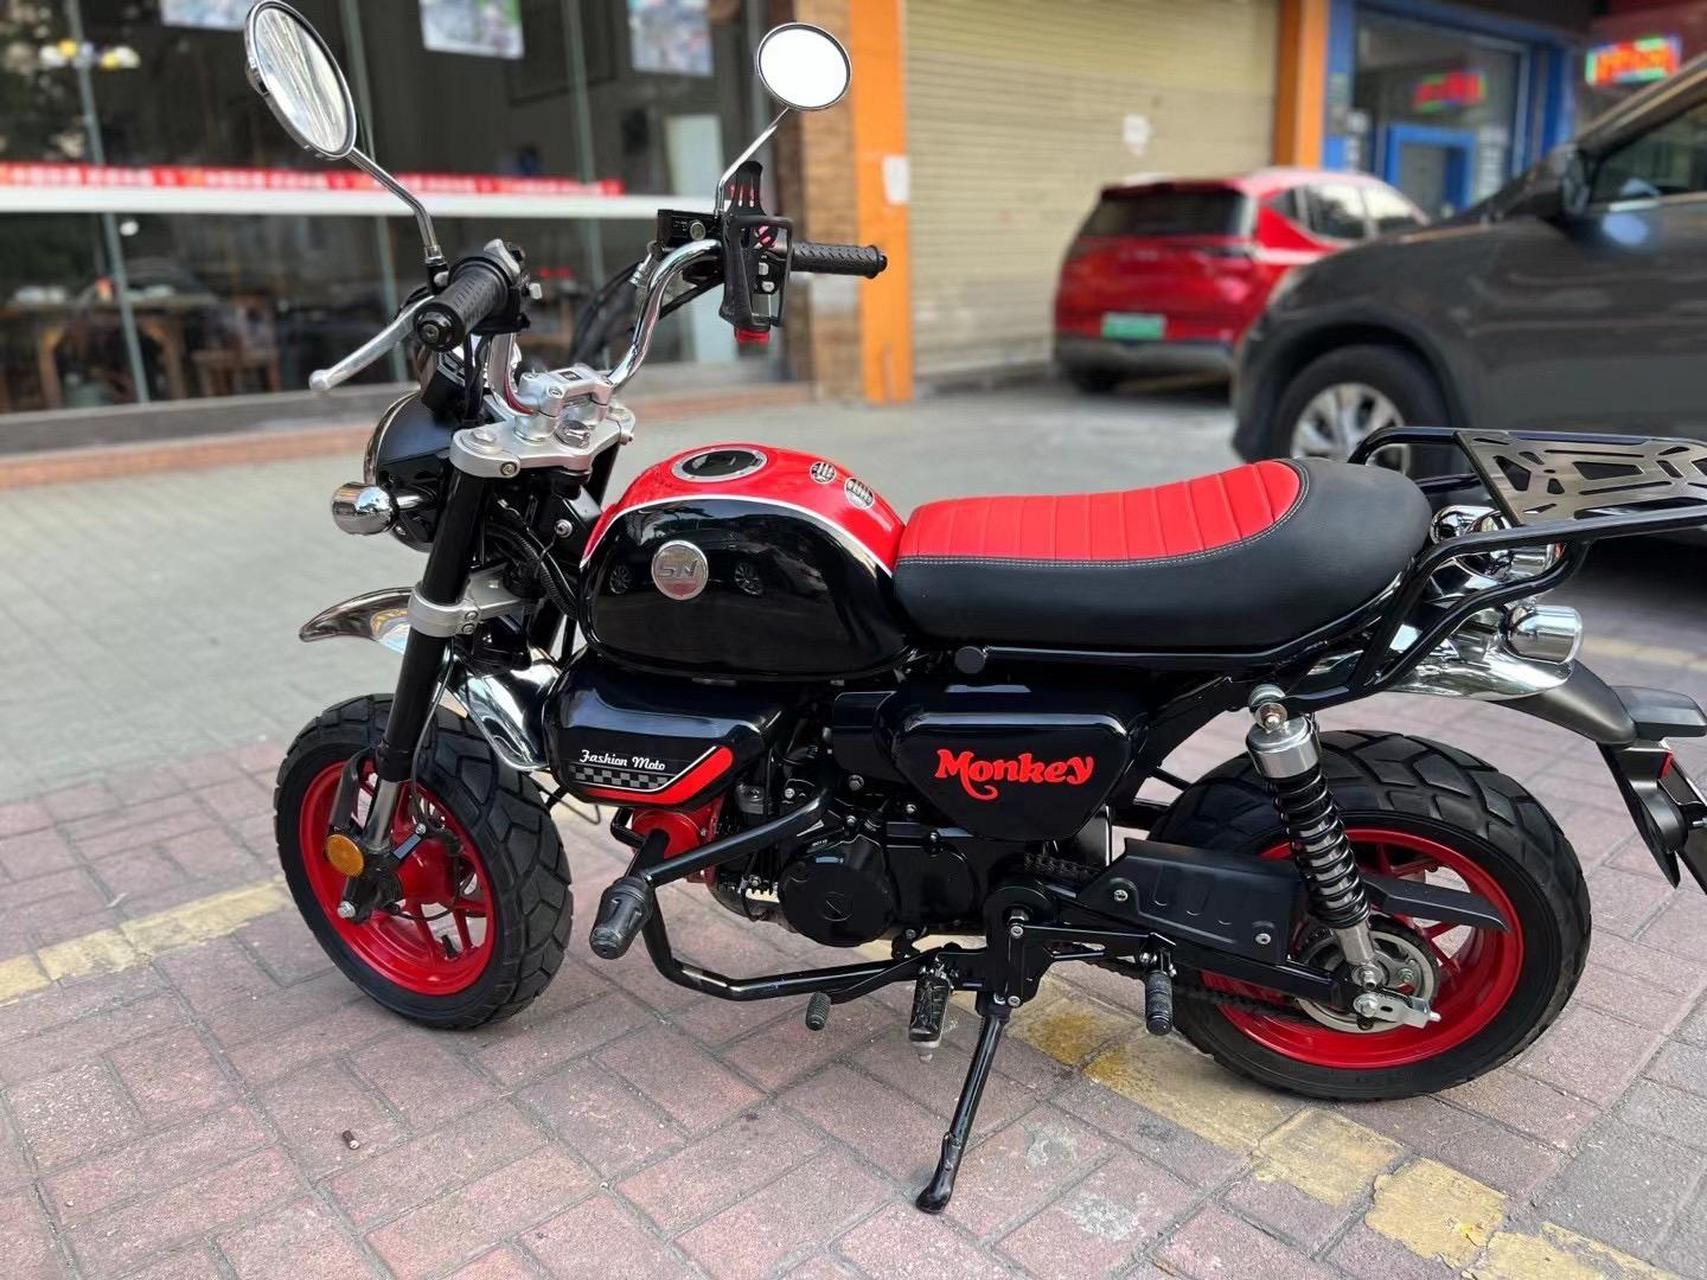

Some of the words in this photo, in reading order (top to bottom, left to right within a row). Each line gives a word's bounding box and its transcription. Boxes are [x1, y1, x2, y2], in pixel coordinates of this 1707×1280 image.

[579, 749, 628, 767] Fashion
[632, 756, 666, 771] Moto
[935, 749, 1094, 800] Monkey
